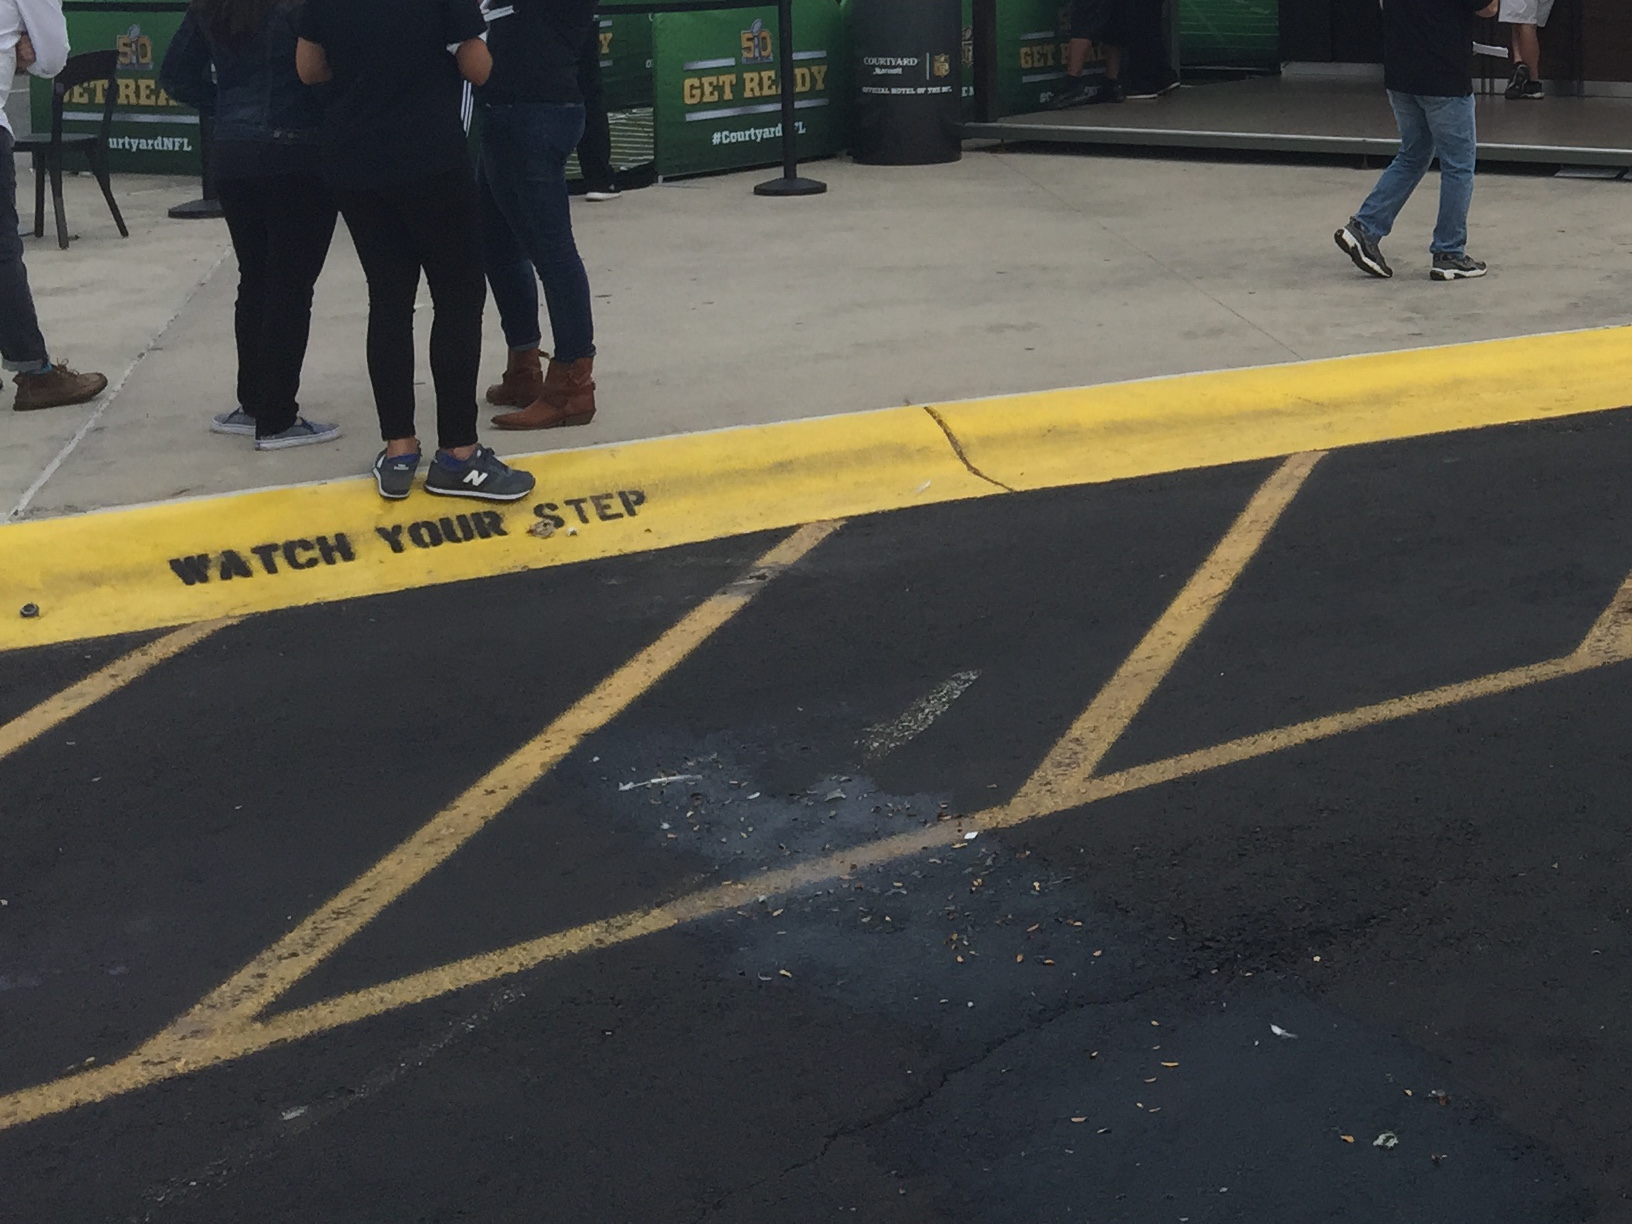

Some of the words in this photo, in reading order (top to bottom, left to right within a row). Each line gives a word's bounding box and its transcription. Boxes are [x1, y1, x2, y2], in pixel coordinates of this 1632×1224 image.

[683, 74, 736, 105] GET
[743, 65, 828, 98] REDY
[108, 137, 192, 153] urtyardNFL
[711, 121, 806, 146] #CourtyardL
[169, 532, 356, 586] WATCH
[375, 509, 509, 554] YOUR
[532, 488, 648, 530] STEP
